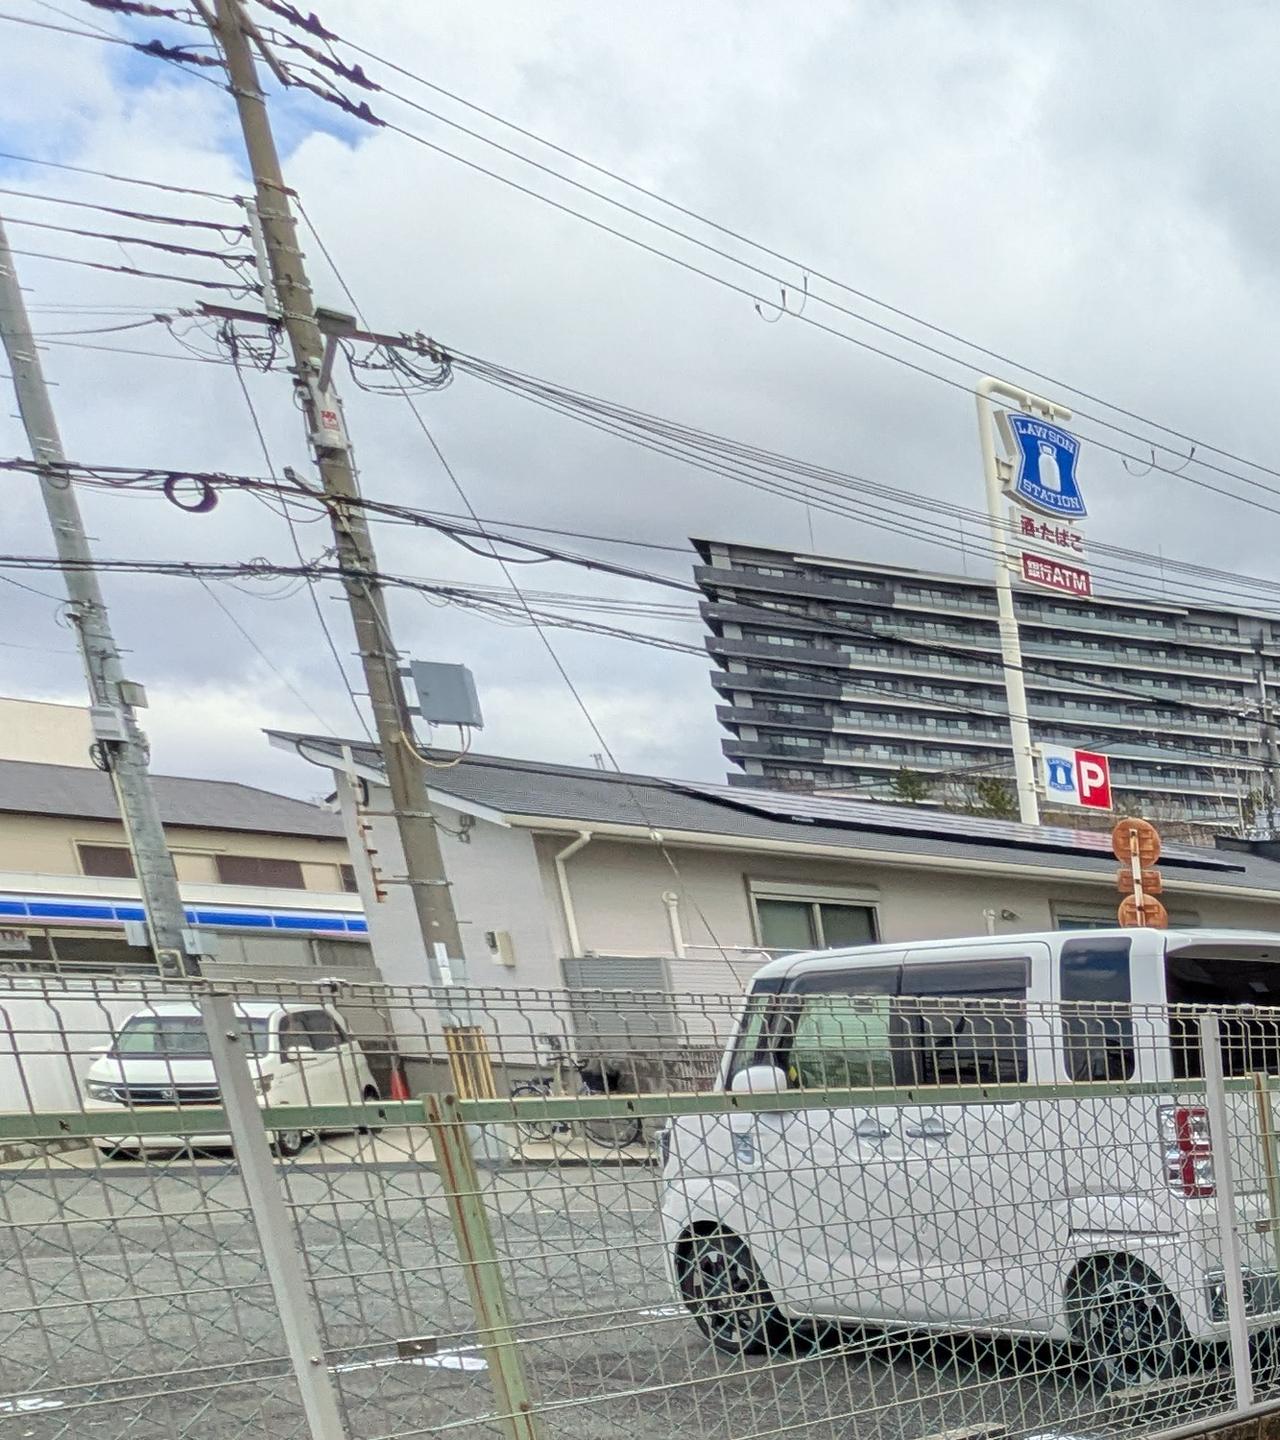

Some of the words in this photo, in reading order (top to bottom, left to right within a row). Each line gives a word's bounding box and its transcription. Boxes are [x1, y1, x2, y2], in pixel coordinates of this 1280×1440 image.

[1016, 421, 1075, 454] LAWSON
[1023, 478, 1081, 509] STATION
[1026, 560, 1088, 592] 銀行ATM
[1079, 760, 1105, 797] P
